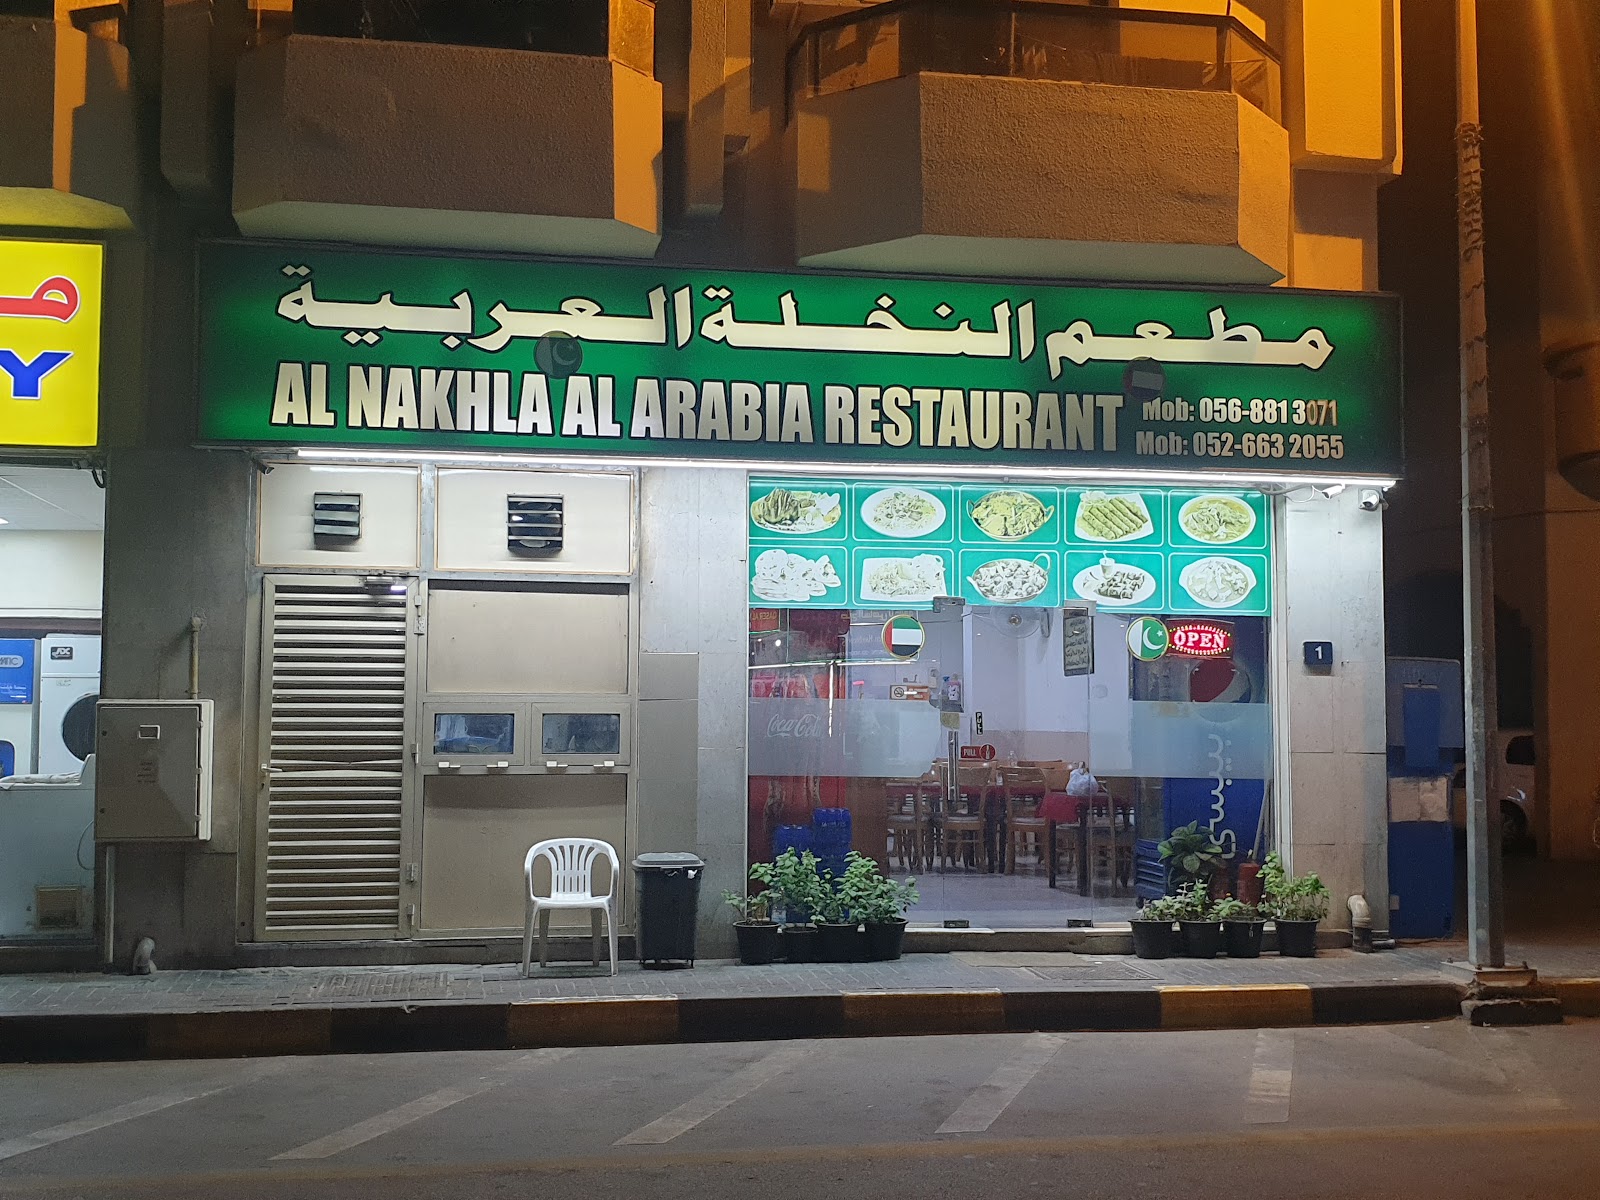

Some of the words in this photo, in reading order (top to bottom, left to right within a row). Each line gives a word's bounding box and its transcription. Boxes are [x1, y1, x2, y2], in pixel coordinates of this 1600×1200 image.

[277, 265, 692, 352] العربية
[700, 286, 1034, 361] النخلة
[1045, 307, 1334, 379] مطعم
[270, 361, 335, 427] AL
[346, 365, 554, 436] NAKHLA
[560, 375, 622, 438] AL
[629, 378, 814, 446] ARABIA
[824, 384, 1124, 452] RESTAURANT
[1142, 397, 1195, 422] Mob:
[1199, 397, 1288, 424] 056-881
[1292, 400, 1339, 427] 3071
[1135, 431, 1189, 456] Mob:
[1192, 432, 1285, 458] 052-663
[1288, 434, 1345, 460] 2055
[1173, 630, 1226, 649] OPEN
[1314, 645, 1323, 660] 1
[963, 748, 977, 757] PULL
